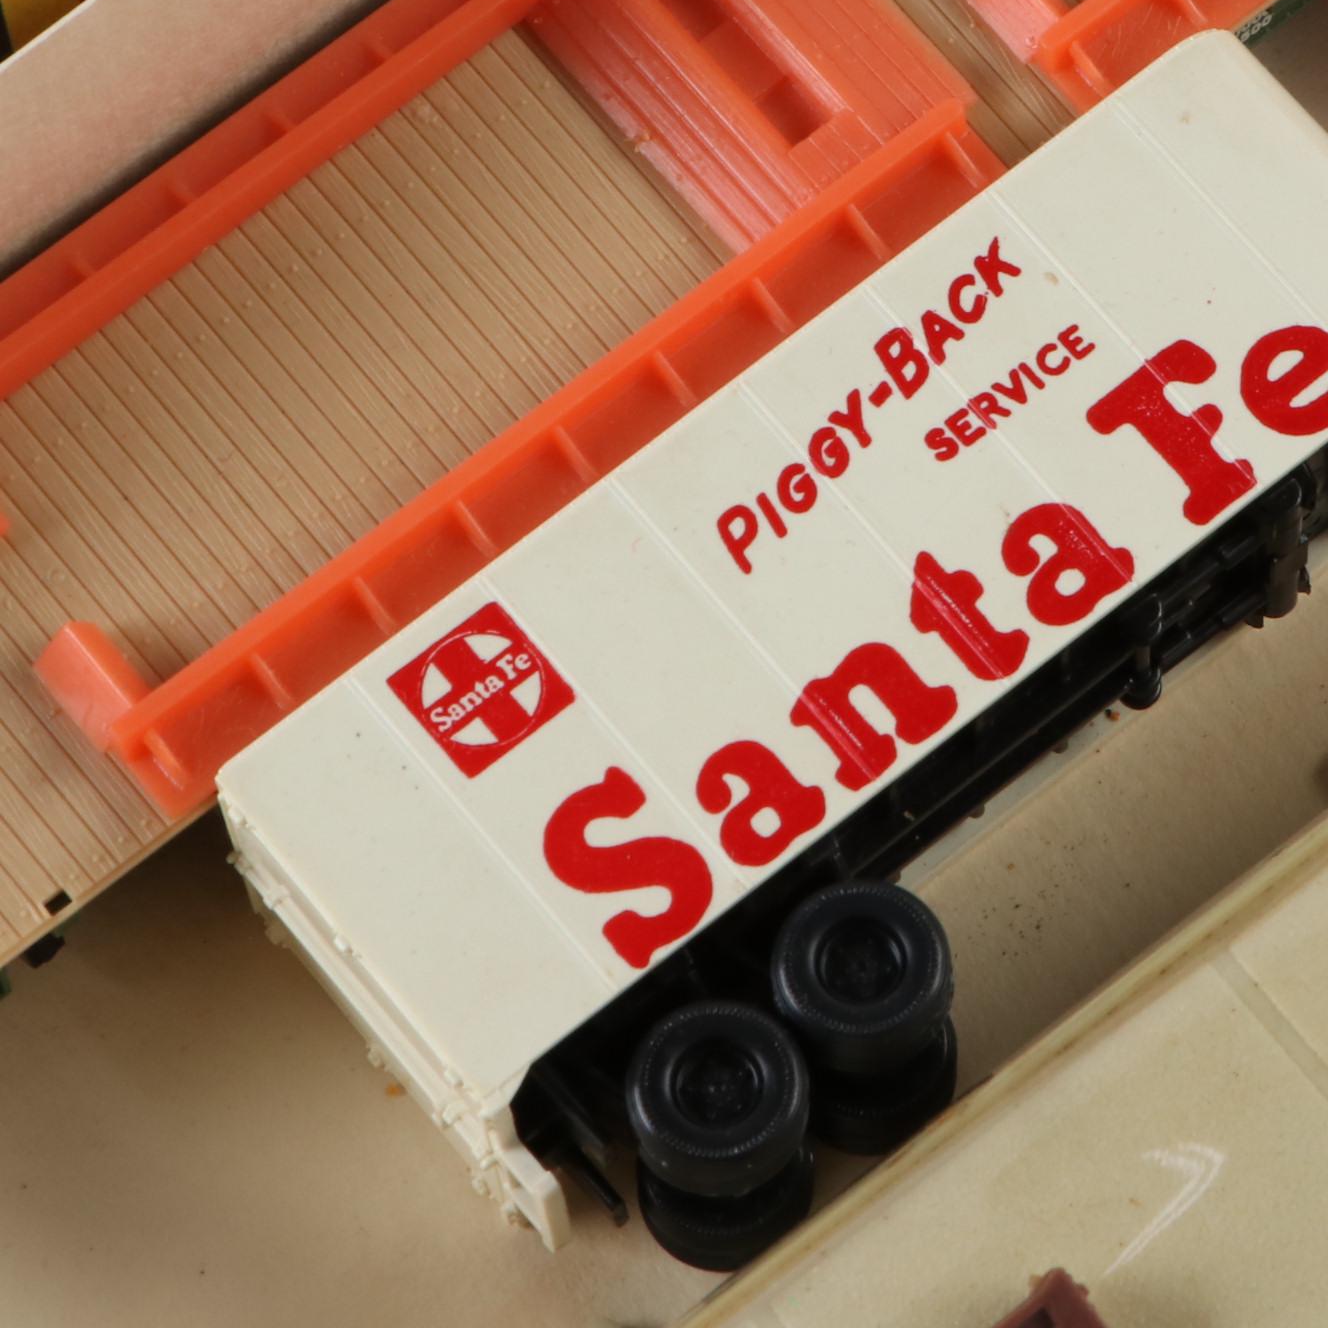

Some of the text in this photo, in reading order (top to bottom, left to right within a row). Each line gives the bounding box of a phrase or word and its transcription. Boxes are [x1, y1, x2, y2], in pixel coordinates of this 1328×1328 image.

[715, 235, 1022, 575] PIGGY-BACK
[923, 323, 1097, 463] SERVICE
[429, 653, 532, 734] Santa Fe
[543, 501, 1135, 970] Santa
